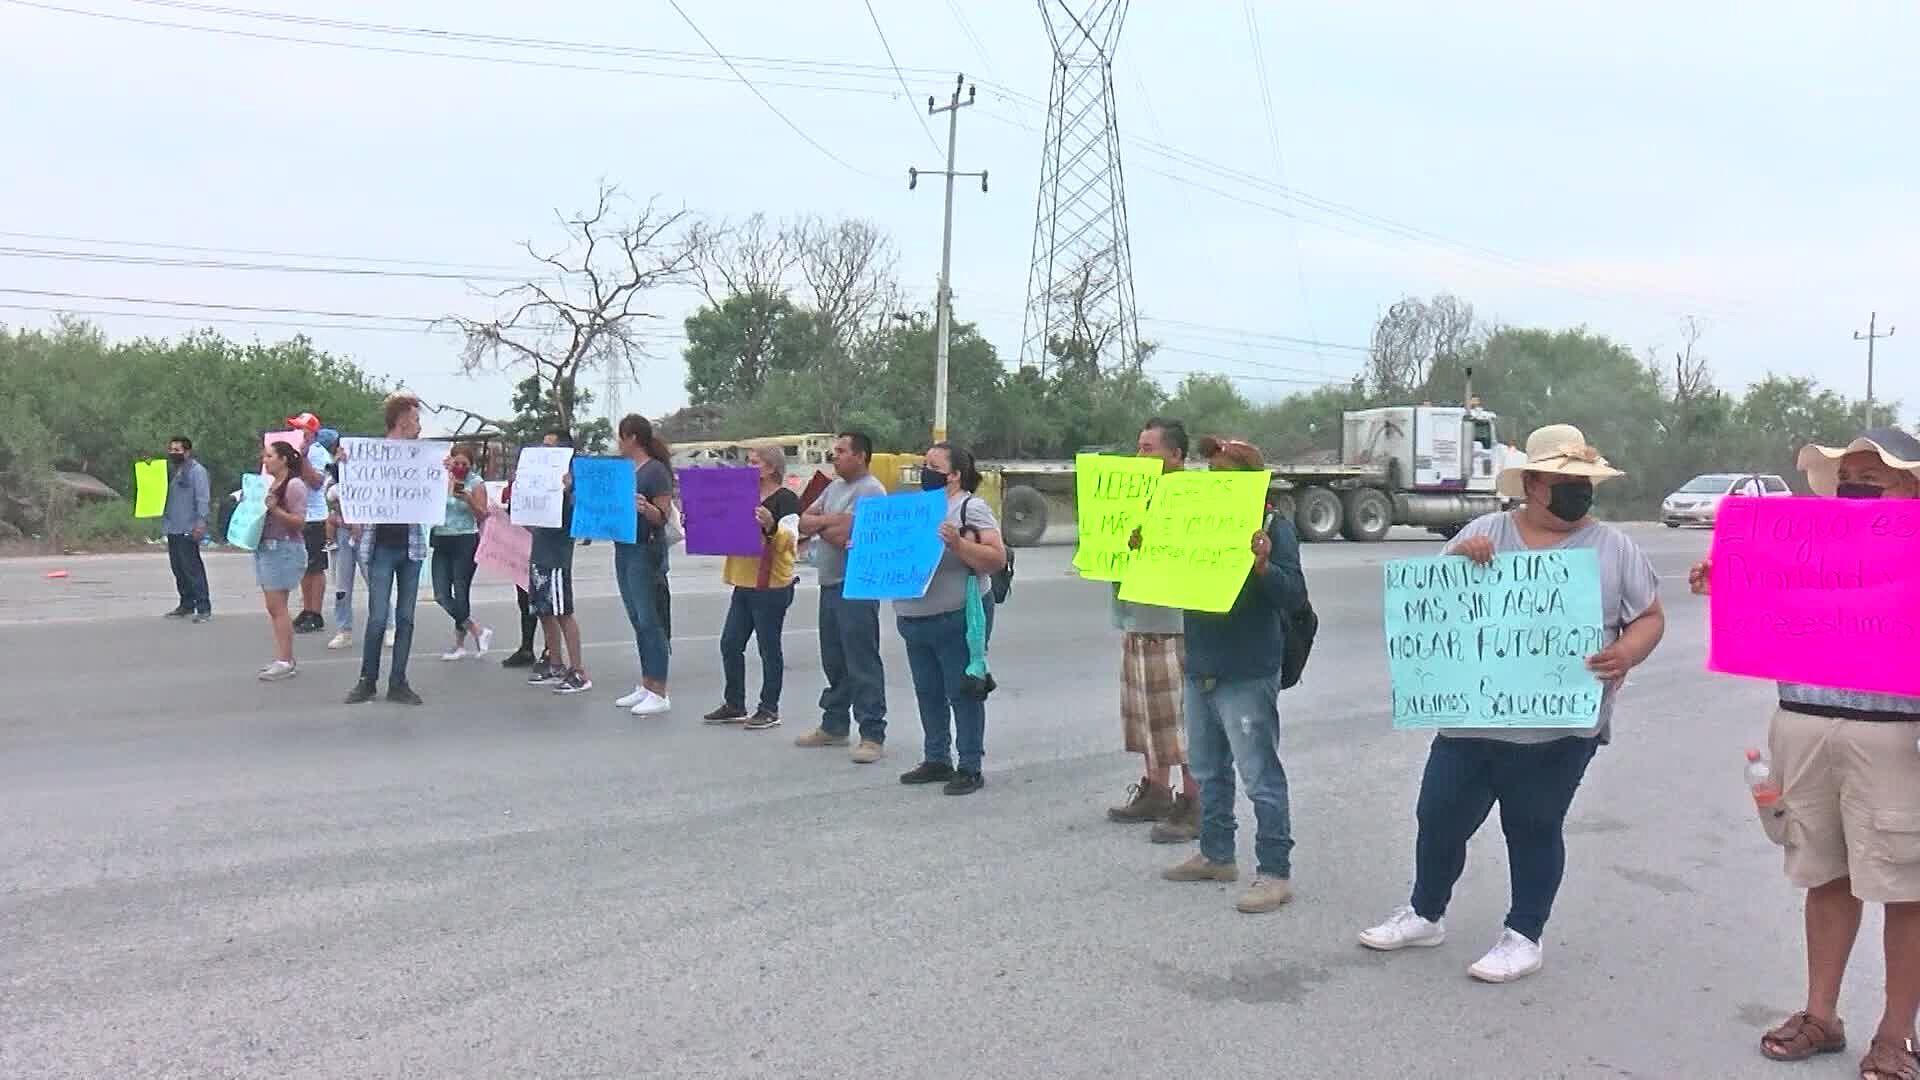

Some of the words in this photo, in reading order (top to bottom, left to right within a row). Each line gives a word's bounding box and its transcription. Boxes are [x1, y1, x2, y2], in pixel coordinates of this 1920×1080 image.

[1772, 513, 1851, 564] agua
[1513, 552, 1569, 584] DIAS
[1404, 596, 1448, 623] MAS
[1457, 590, 1491, 623] SIN
[1503, 587, 1566, 619] AGUA
[1390, 628, 1465, 662] HOGAR
